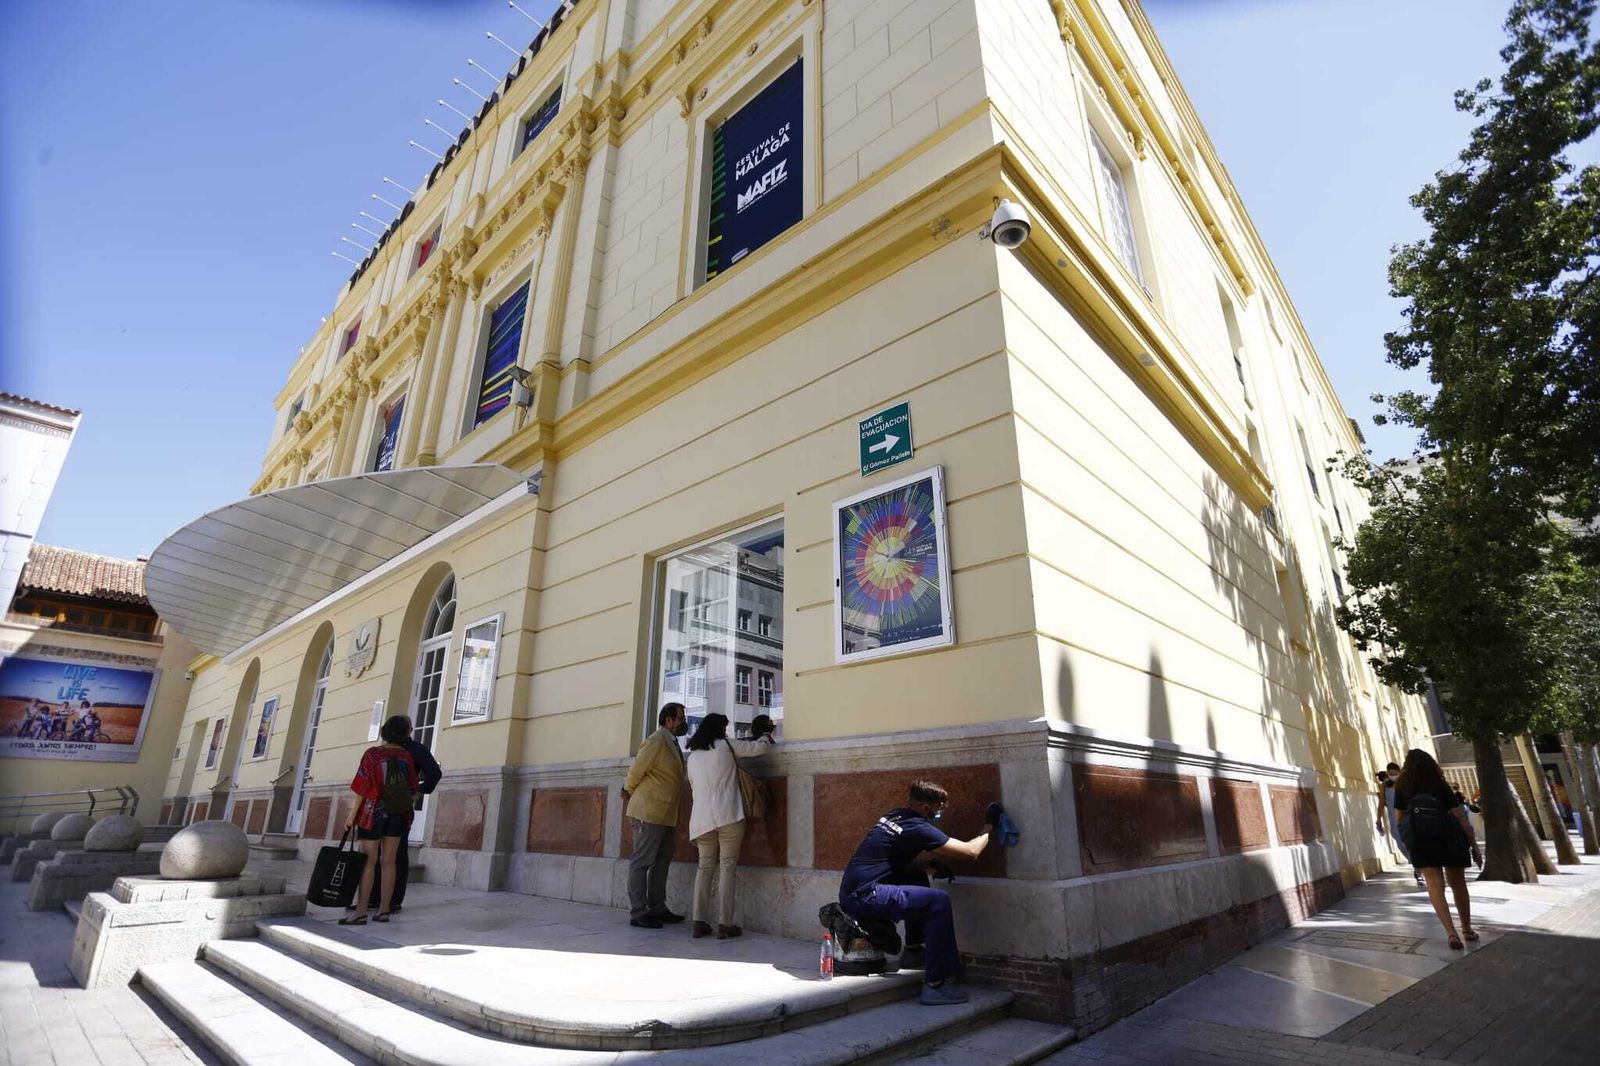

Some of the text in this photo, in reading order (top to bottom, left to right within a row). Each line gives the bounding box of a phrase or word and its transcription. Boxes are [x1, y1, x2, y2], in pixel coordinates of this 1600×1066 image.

[736, 122, 790, 169] FESTIVAL DE
[737, 158, 787, 210] MAFIZ
[861, 415, 884, 431] VIA DE
[861, 413, 908, 439] EVACUACION
[63, 665, 97, 681] LIVE
[57, 686, 90, 700] LIFE
